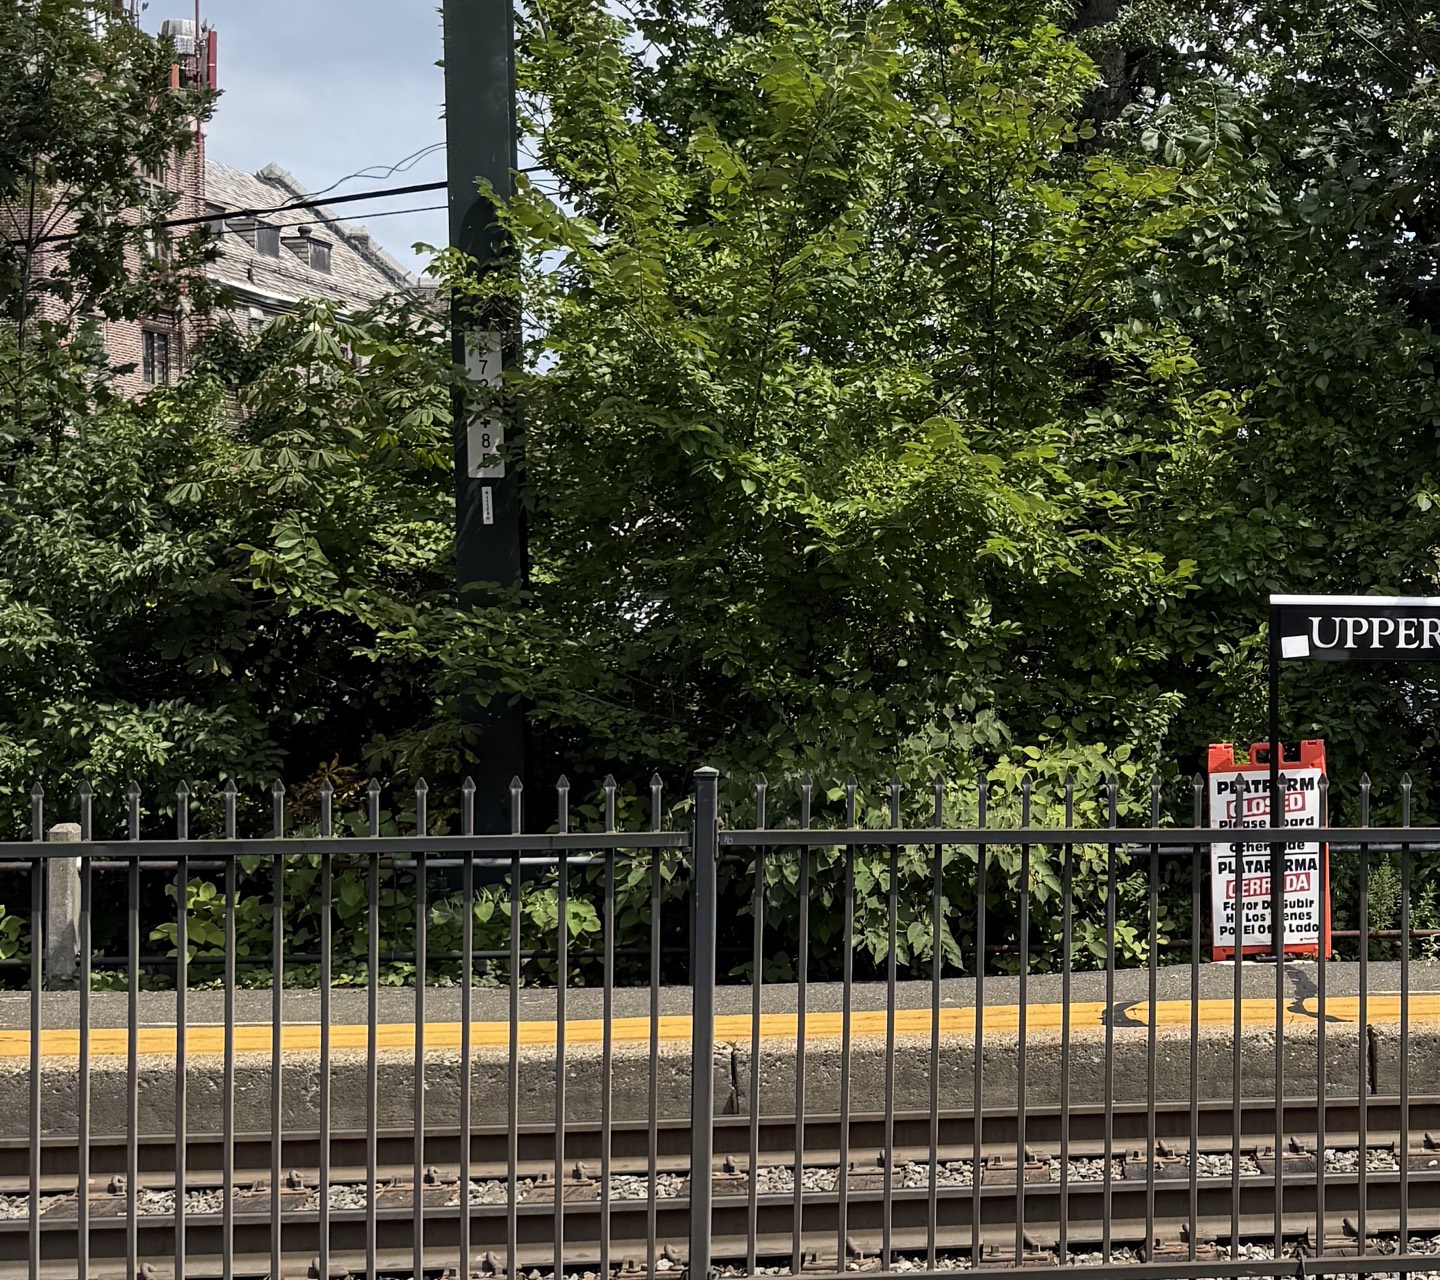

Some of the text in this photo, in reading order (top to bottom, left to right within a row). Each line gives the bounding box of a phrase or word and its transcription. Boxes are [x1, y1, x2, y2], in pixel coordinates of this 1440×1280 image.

[1217, 777, 1315, 795] PLATFRM
[1218, 858, 1318, 875] PLTAFRMA
[1228, 874, 1309, 898] CERRDA
[1246, 913, 1266, 922] Los
[1220, 926, 1235, 936] Po
[1243, 925, 1255, 934] El
[1289, 923, 1319, 933] Lado
